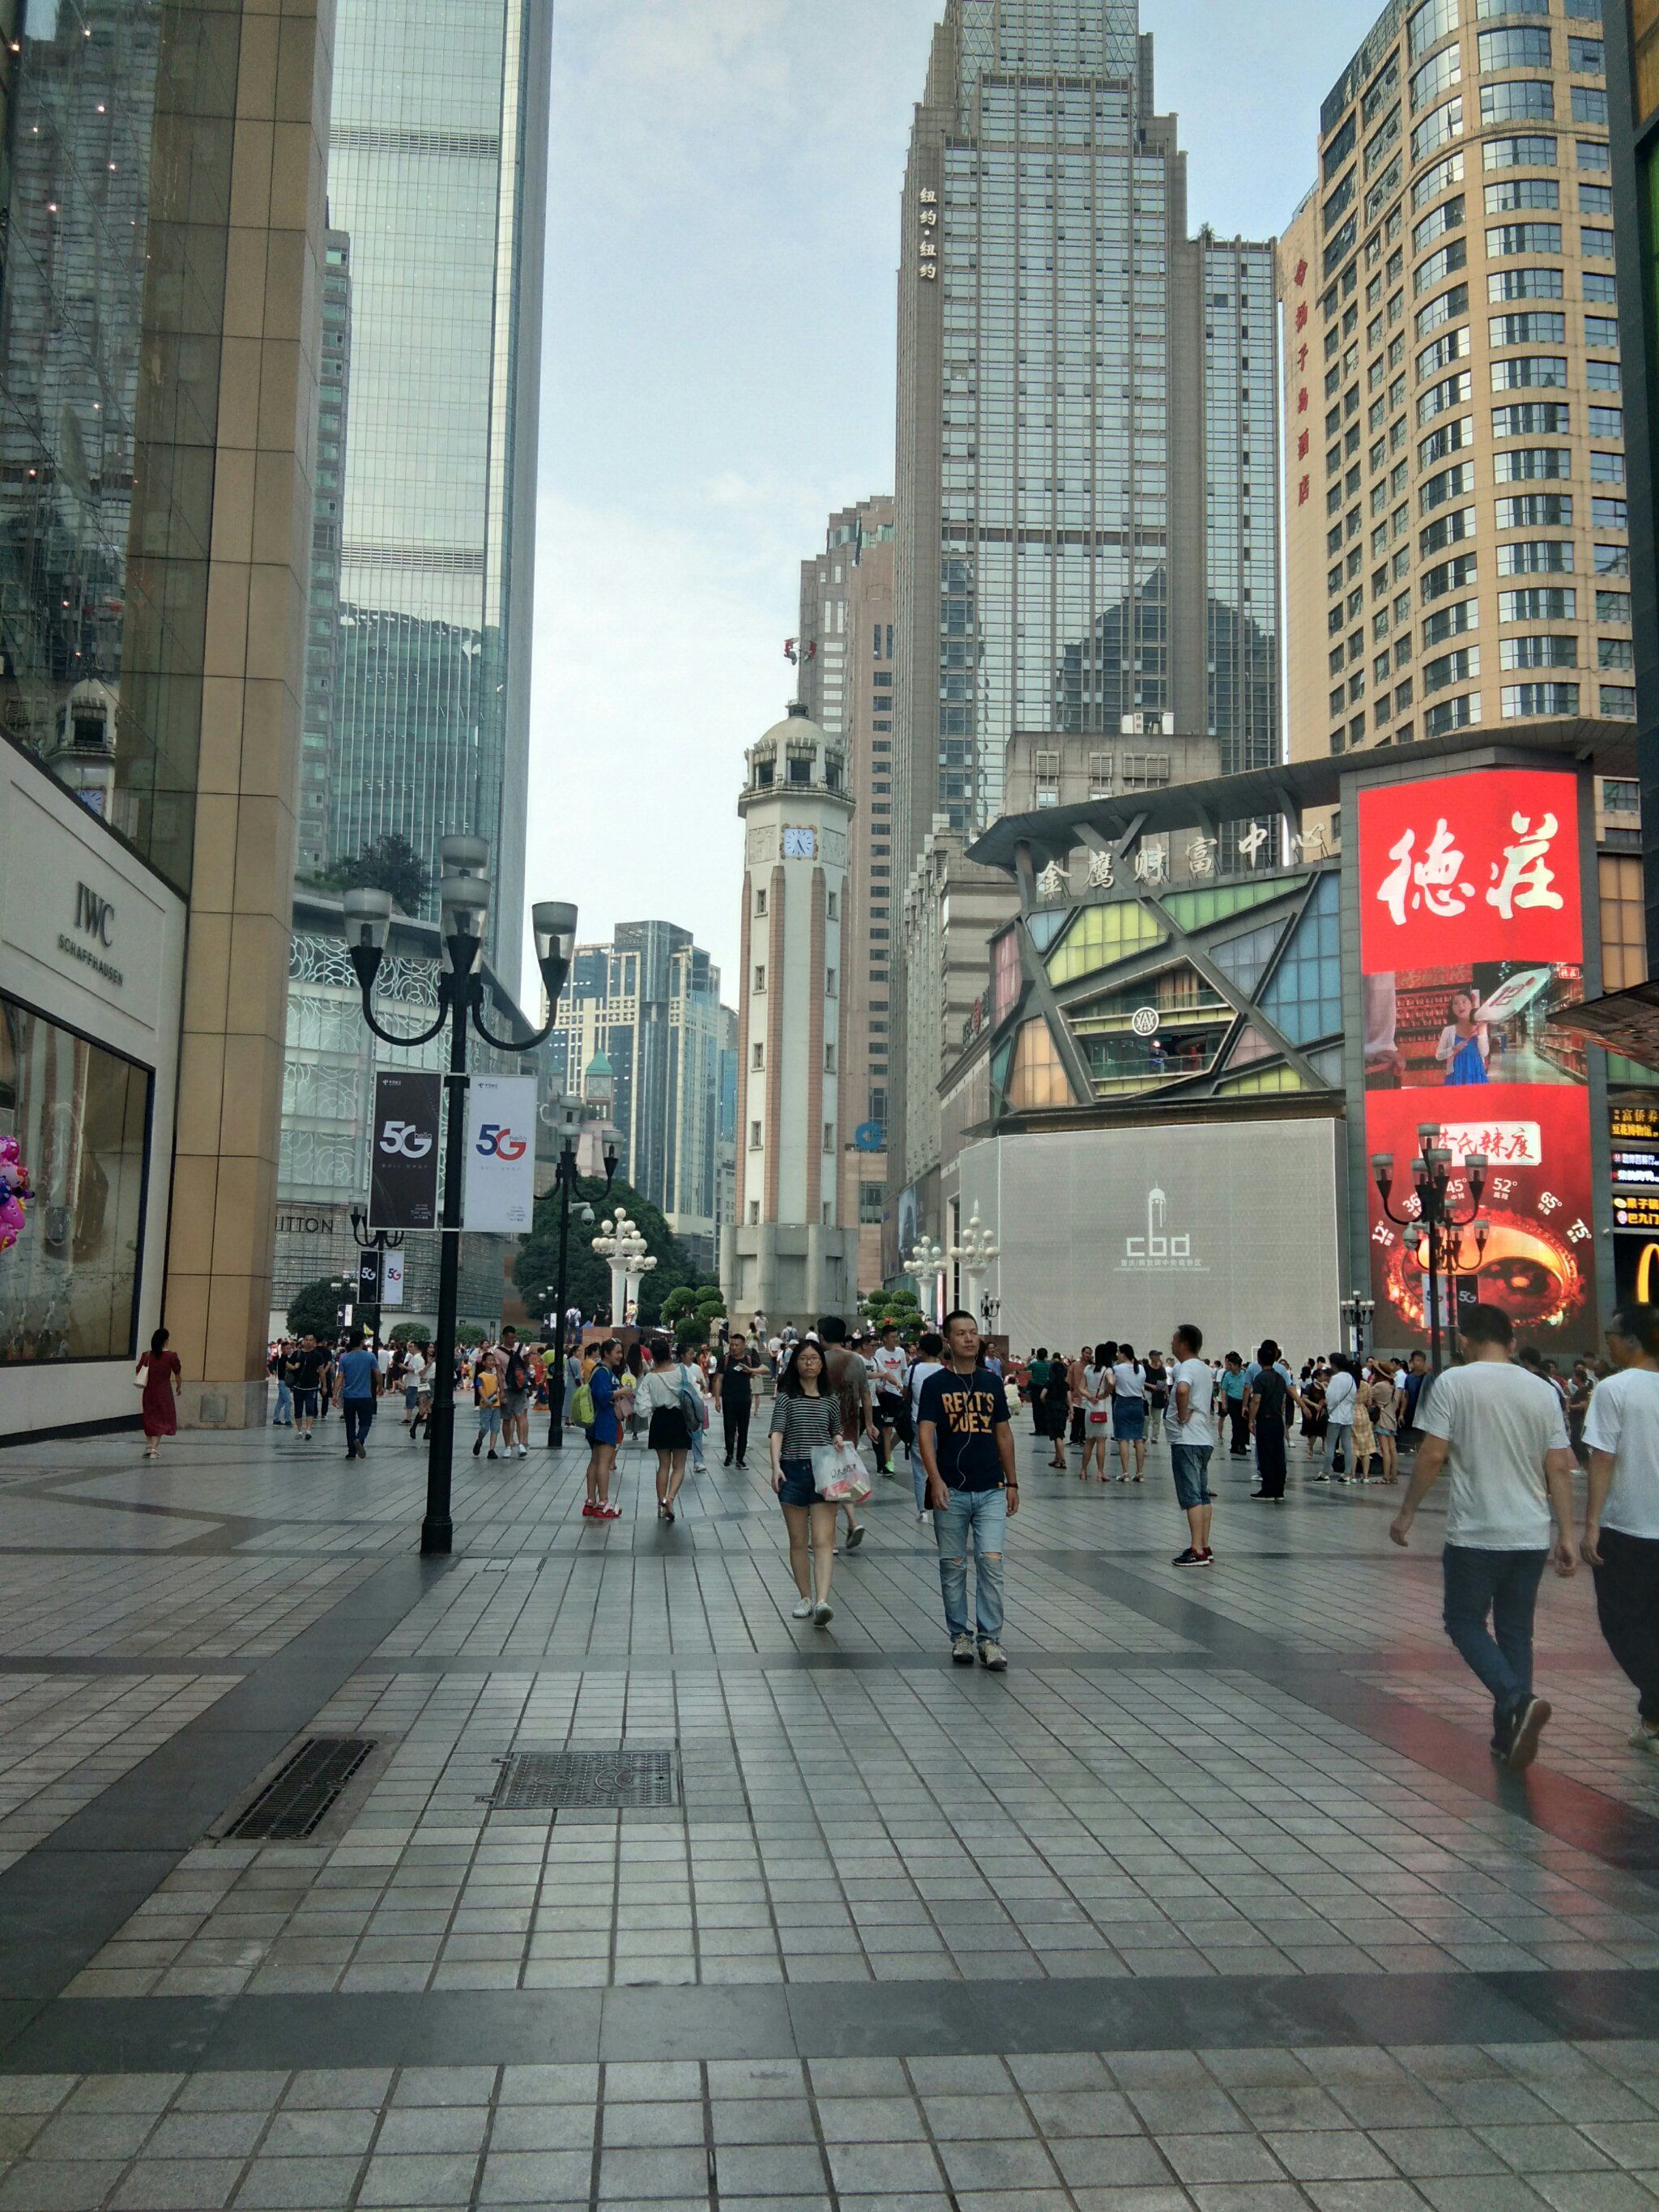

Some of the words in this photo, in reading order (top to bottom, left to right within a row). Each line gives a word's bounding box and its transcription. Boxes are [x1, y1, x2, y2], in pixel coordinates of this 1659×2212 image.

[75, 881, 114, 948] IWC
[58, 934, 123, 987] SCHAFFHAUSEN
[380, 1121, 432, 1158] 5G
[476, 1124, 527, 1161] 5G
[275, 1217, 333, 1234] ITTON
[361, 1268, 376, 1281] 5G
[388, 1268, 401, 1281] 5G
[1459, 1291, 1477, 1303] 5G
